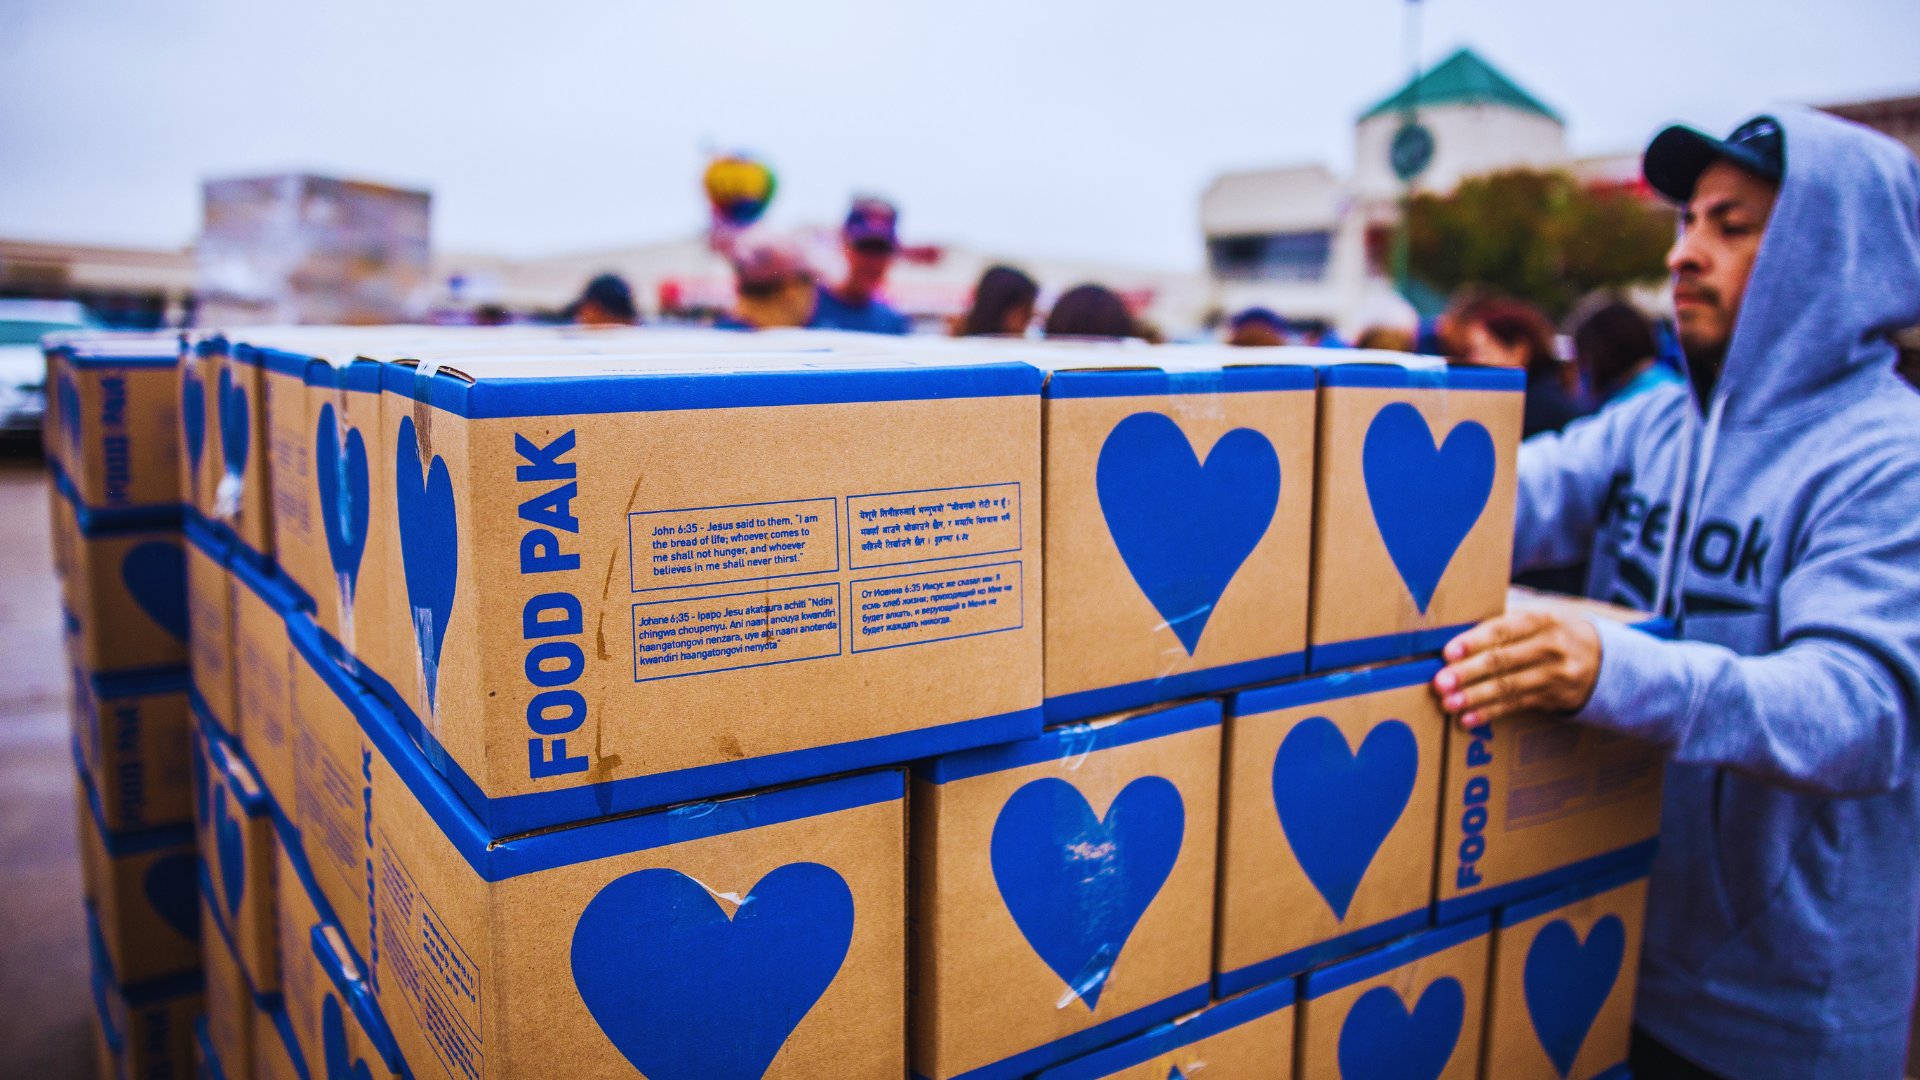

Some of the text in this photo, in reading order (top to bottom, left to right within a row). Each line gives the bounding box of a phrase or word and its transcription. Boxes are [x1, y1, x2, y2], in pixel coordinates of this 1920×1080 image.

[652, 527, 675, 538] John
[678, 523, 698, 535] 6:35
[708, 523, 733, 532] Jesus
[736, 519, 754, 530] said
[767, 518, 792, 527] them,
[804, 516, 818, 524] am
[652, 528, 810, 550] the bread of life; whoever comes to
[1599, 467, 1772, 587] Reeok
[653, 542, 805, 563] me shall not hunger, and whoever
[653, 566, 692, 577] believes
[706, 563, 720, 571] me
[722, 559, 744, 570] shall
[748, 558, 772, 567] never
[515, 429, 589, 778] FOOD PAK
[639, 617, 669, 628] Johane
[698, 612, 721, 622] Ipapo
[724, 609, 743, 618] Jesu
[746, 604, 782, 615] akataura
[784, 600, 806, 611] achiti
[639, 609, 835, 640] chingwa choupenyu. Ani naani anouya kwandiri
[640, 621, 838, 653] haangatongovi nenzara, uye ani naani anotenda
[640, 654, 678, 666] kwandiri
[680, 646, 743, 661] haangatongovi
[1457, 721, 1493, 890] FOOD PA
